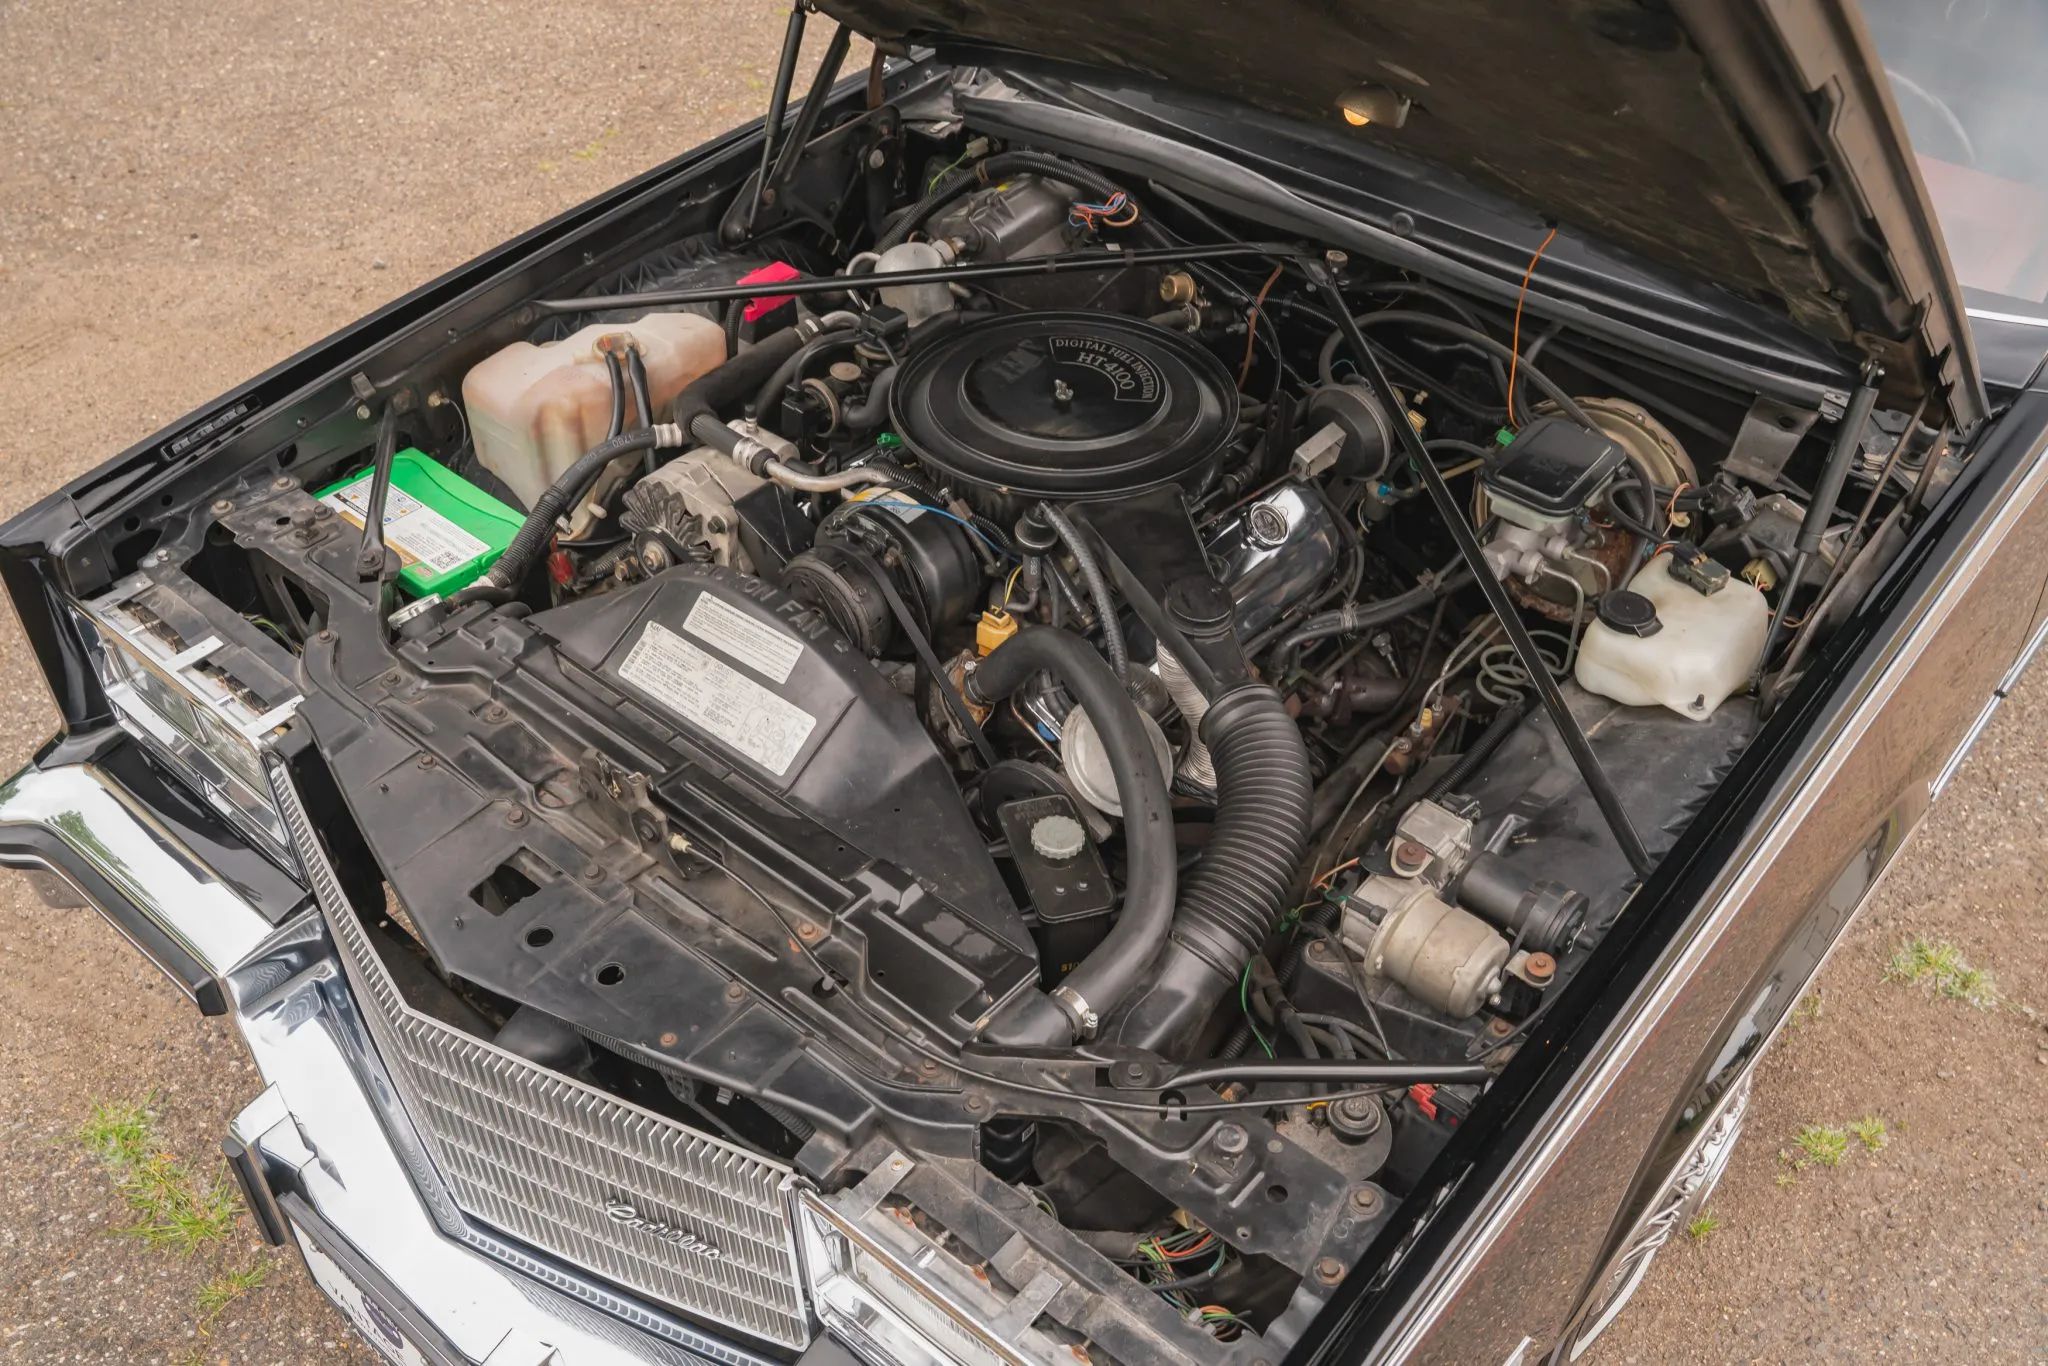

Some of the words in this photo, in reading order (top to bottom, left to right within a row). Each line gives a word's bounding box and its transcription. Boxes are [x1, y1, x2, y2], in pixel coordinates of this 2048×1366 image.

[1056, 339, 1106, 352] DIGITAL
[1108, 346, 1135, 364] FUEL
[1131, 361, 1154, 399] INJECTION
[776, 599, 829, 640] FAN
[606, 1199, 721, 1260] Cadillac
